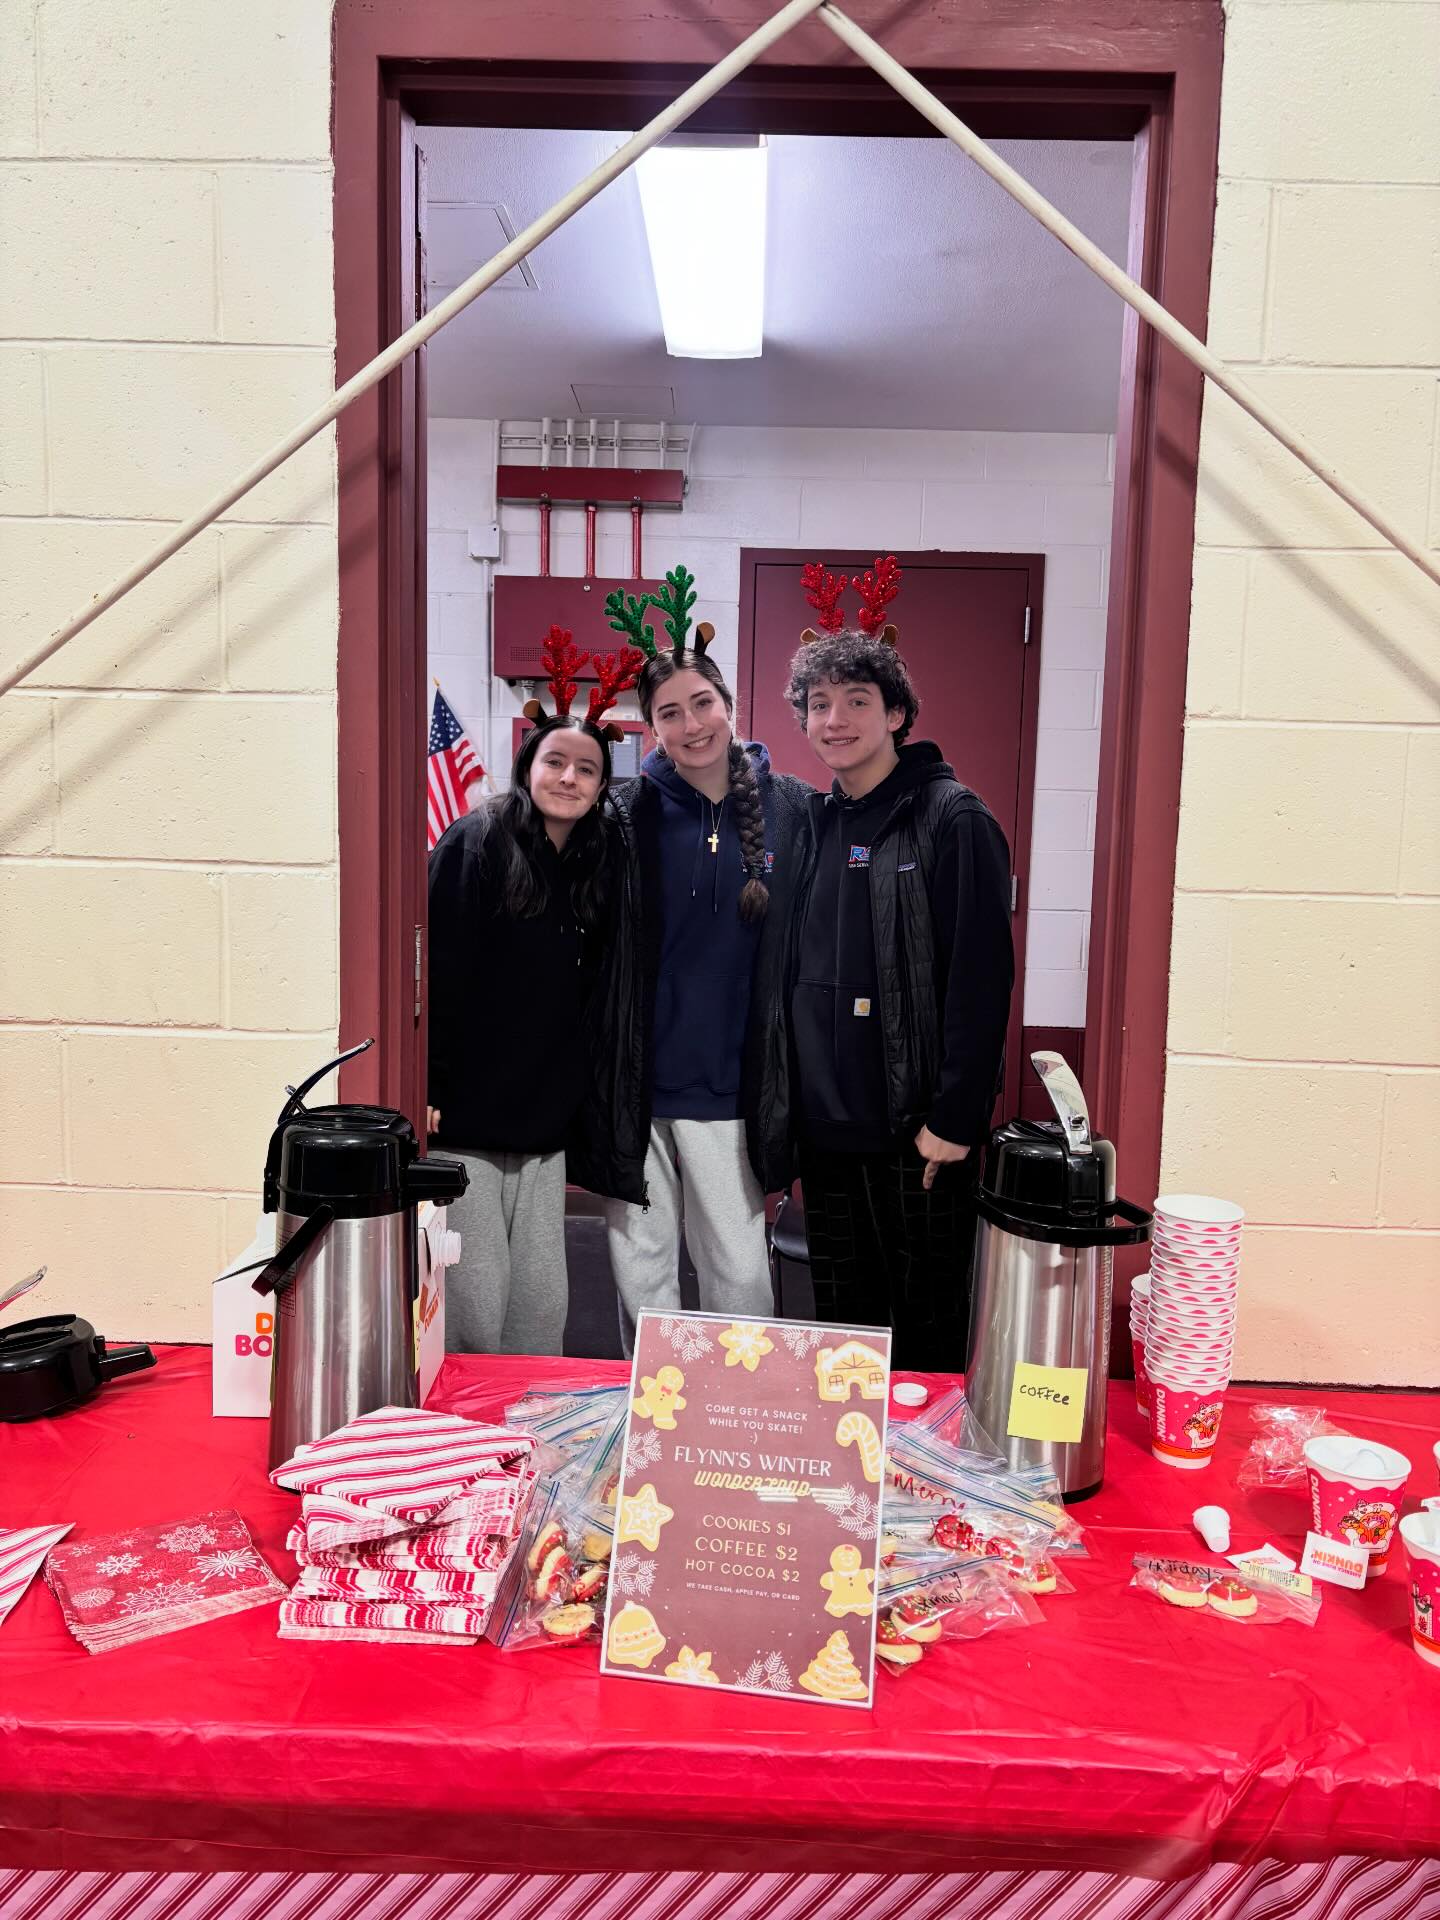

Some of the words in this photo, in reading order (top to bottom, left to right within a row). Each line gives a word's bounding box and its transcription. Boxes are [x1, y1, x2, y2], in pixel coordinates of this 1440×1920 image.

[235, 1334, 273, 1357] BO
[705, 1403, 735, 1415] COME
[739, 1407, 758, 1417] GET
[762, 1409, 769, 1418] A
[773, 1410, 808, 1422] SNACK
[708, 1417, 738, 1428] WHILE
[742, 1420, 764, 1431] YOU
[767, 1423, 803, 1434] SKATE!
[674, 1445, 751, 1469] FLYNN'S
[758, 1453, 832, 1477] WINTER
[1310, 1474, 1322, 1535] DUNKIN
[702, 1514, 771, 1534] COOKIES
[776, 1522, 791, 1536] $1
[695, 1536, 767, 1558] COFFEE
[775, 1545, 798, 1561] $2
[685, 1558, 716, 1572] HOT
[720, 1562, 776, 1580] COCOA
[782, 1568, 800, 1582] $2
[697, 1583, 712, 1591] TAKE
[735, 1588, 754, 1596] APPLE
[782, 1593, 800, 1601] CARD
